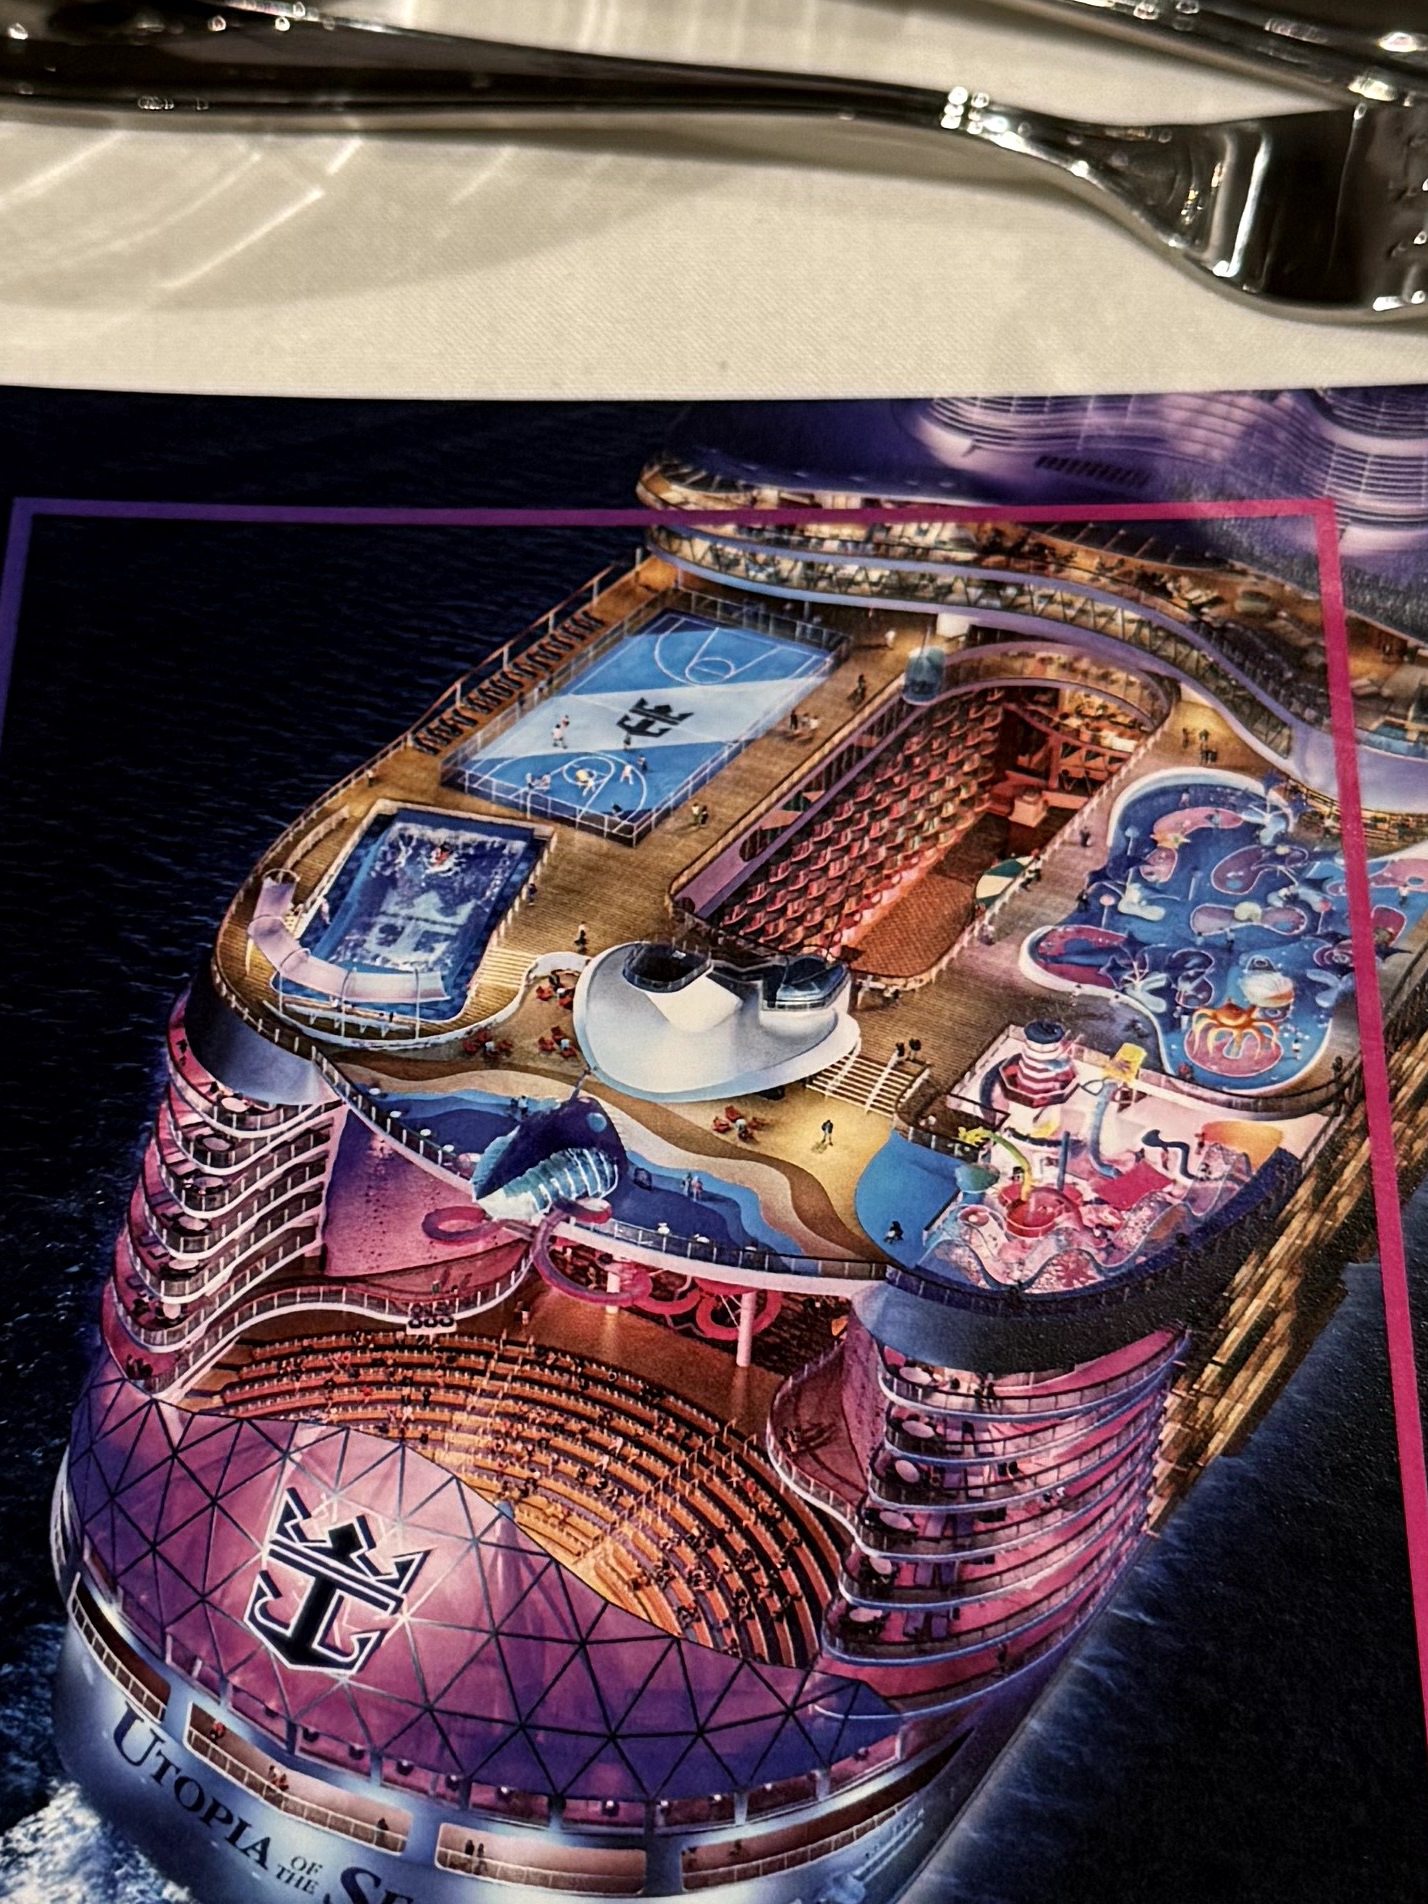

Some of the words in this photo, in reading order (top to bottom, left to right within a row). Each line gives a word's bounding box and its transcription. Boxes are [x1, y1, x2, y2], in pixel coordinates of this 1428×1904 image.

[113, 1700, 273, 1870] UTOPIA
[275, 1863, 320, 1895] THE
[290, 1855, 324, 1877] OF
